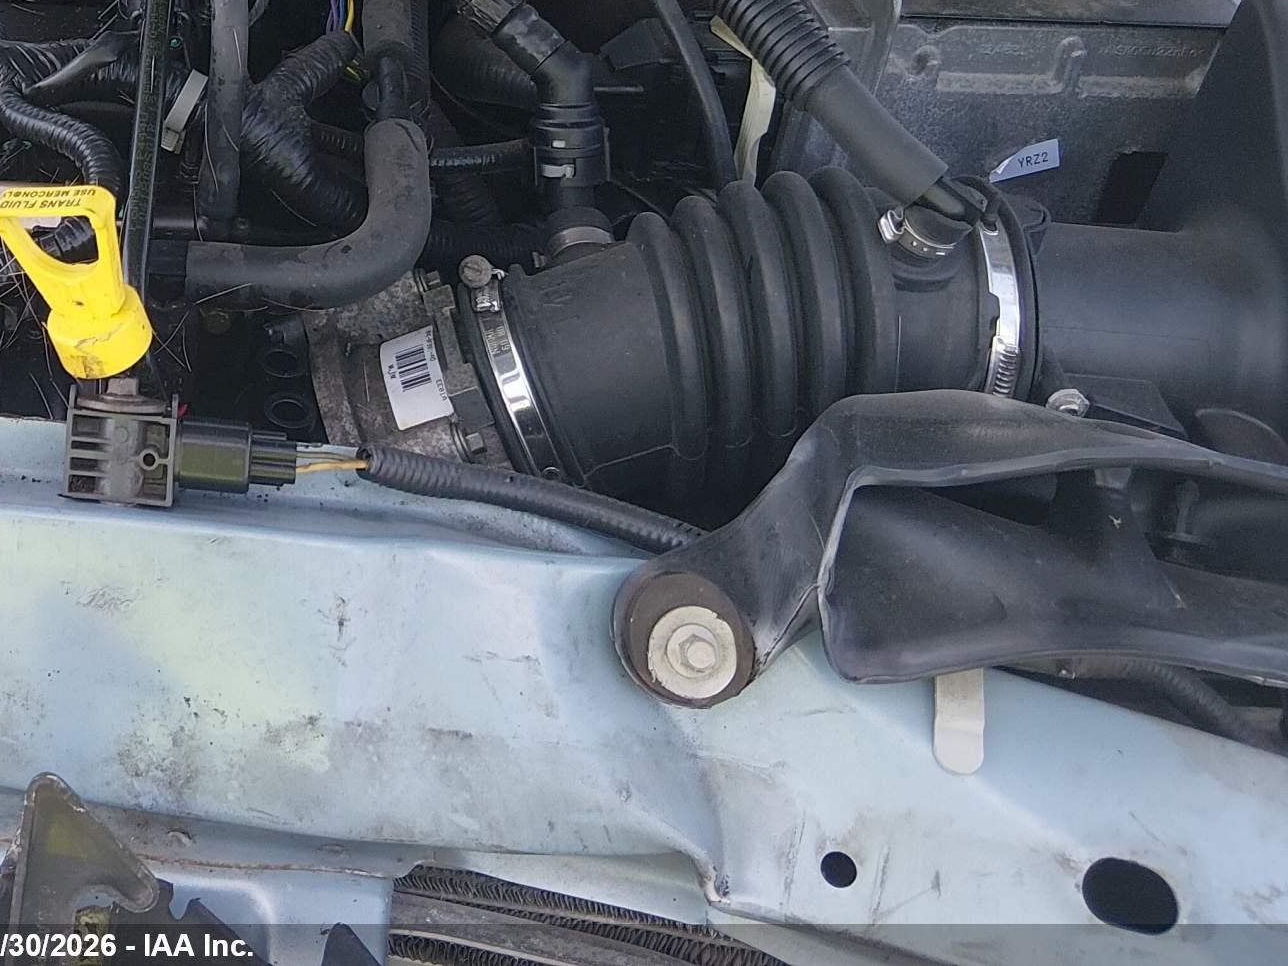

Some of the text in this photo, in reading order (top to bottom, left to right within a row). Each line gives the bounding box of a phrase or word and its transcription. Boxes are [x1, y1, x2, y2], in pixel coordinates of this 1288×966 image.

[1017, 151, 1049, 168] YRZ2
[73, 188, 96, 196] USE
[0, 198, 82, 209] TRANS FLUID
